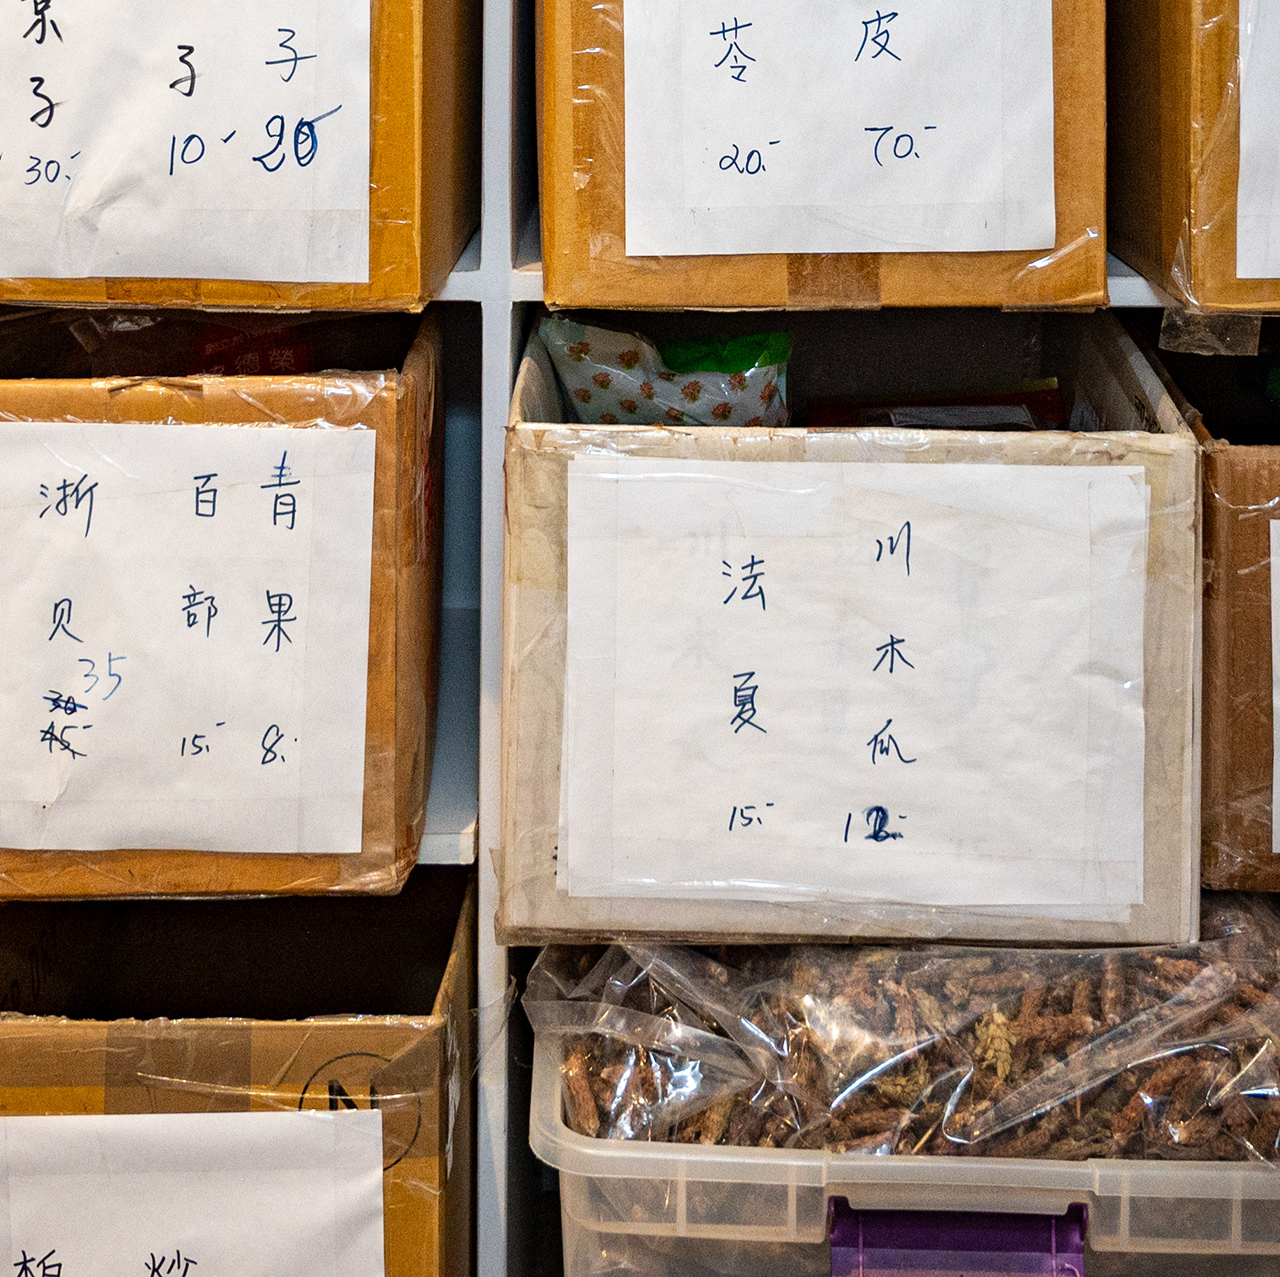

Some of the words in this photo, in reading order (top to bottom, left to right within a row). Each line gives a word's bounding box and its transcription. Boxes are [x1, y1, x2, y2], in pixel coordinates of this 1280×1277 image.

[38, 473, 100, 644] 浙贝
[180, 471, 220, 638] 百部
[259, 449, 302, 653] 青果
[721, 553, 768, 735] 法夏
[865, 520, 918, 766] 川木瓜
